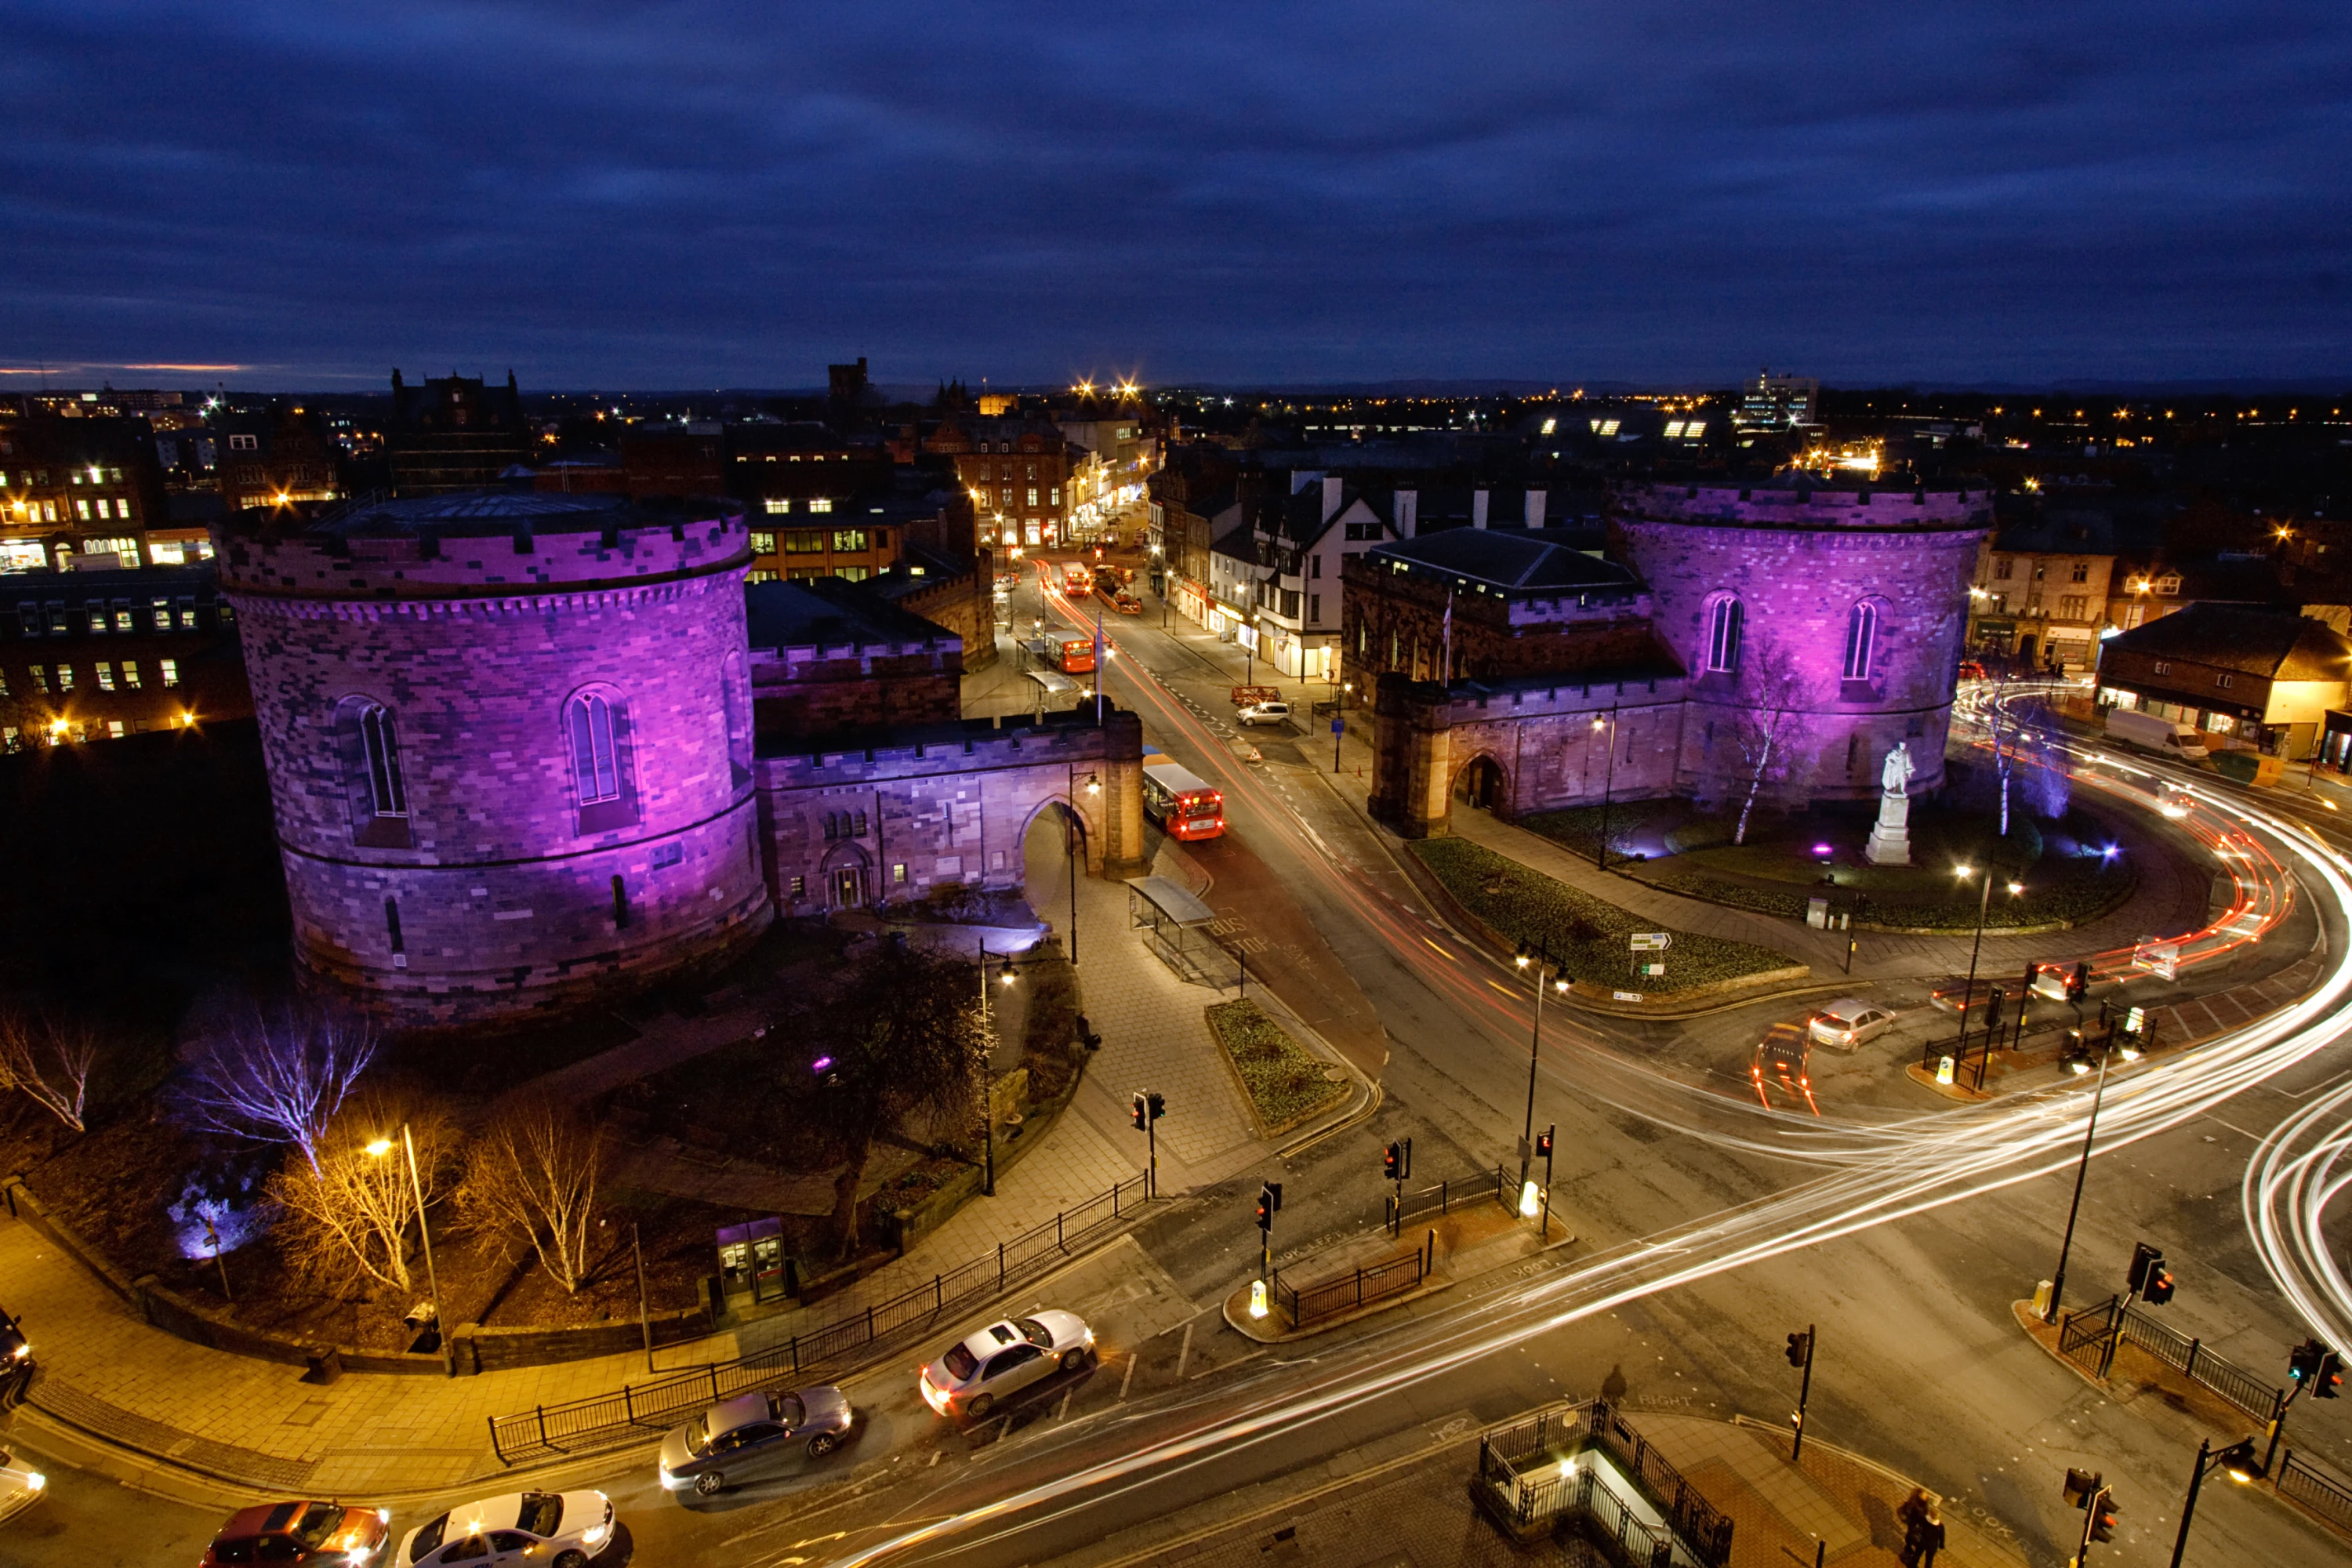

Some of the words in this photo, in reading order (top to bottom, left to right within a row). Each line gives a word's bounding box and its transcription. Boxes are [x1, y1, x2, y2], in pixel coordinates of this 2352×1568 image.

[1209, 917, 1247, 936] BUS
[1221, 936, 1268, 957] STOP
[1307, 1230, 1342, 1250] LEFT
[1513, 1258, 1552, 1277] LOOK
[1472, 1275, 1508, 1292] LEFT
[1638, 1394, 1692, 1407] RIGHT
[1959, 1496, 2016, 1538] LOOK
